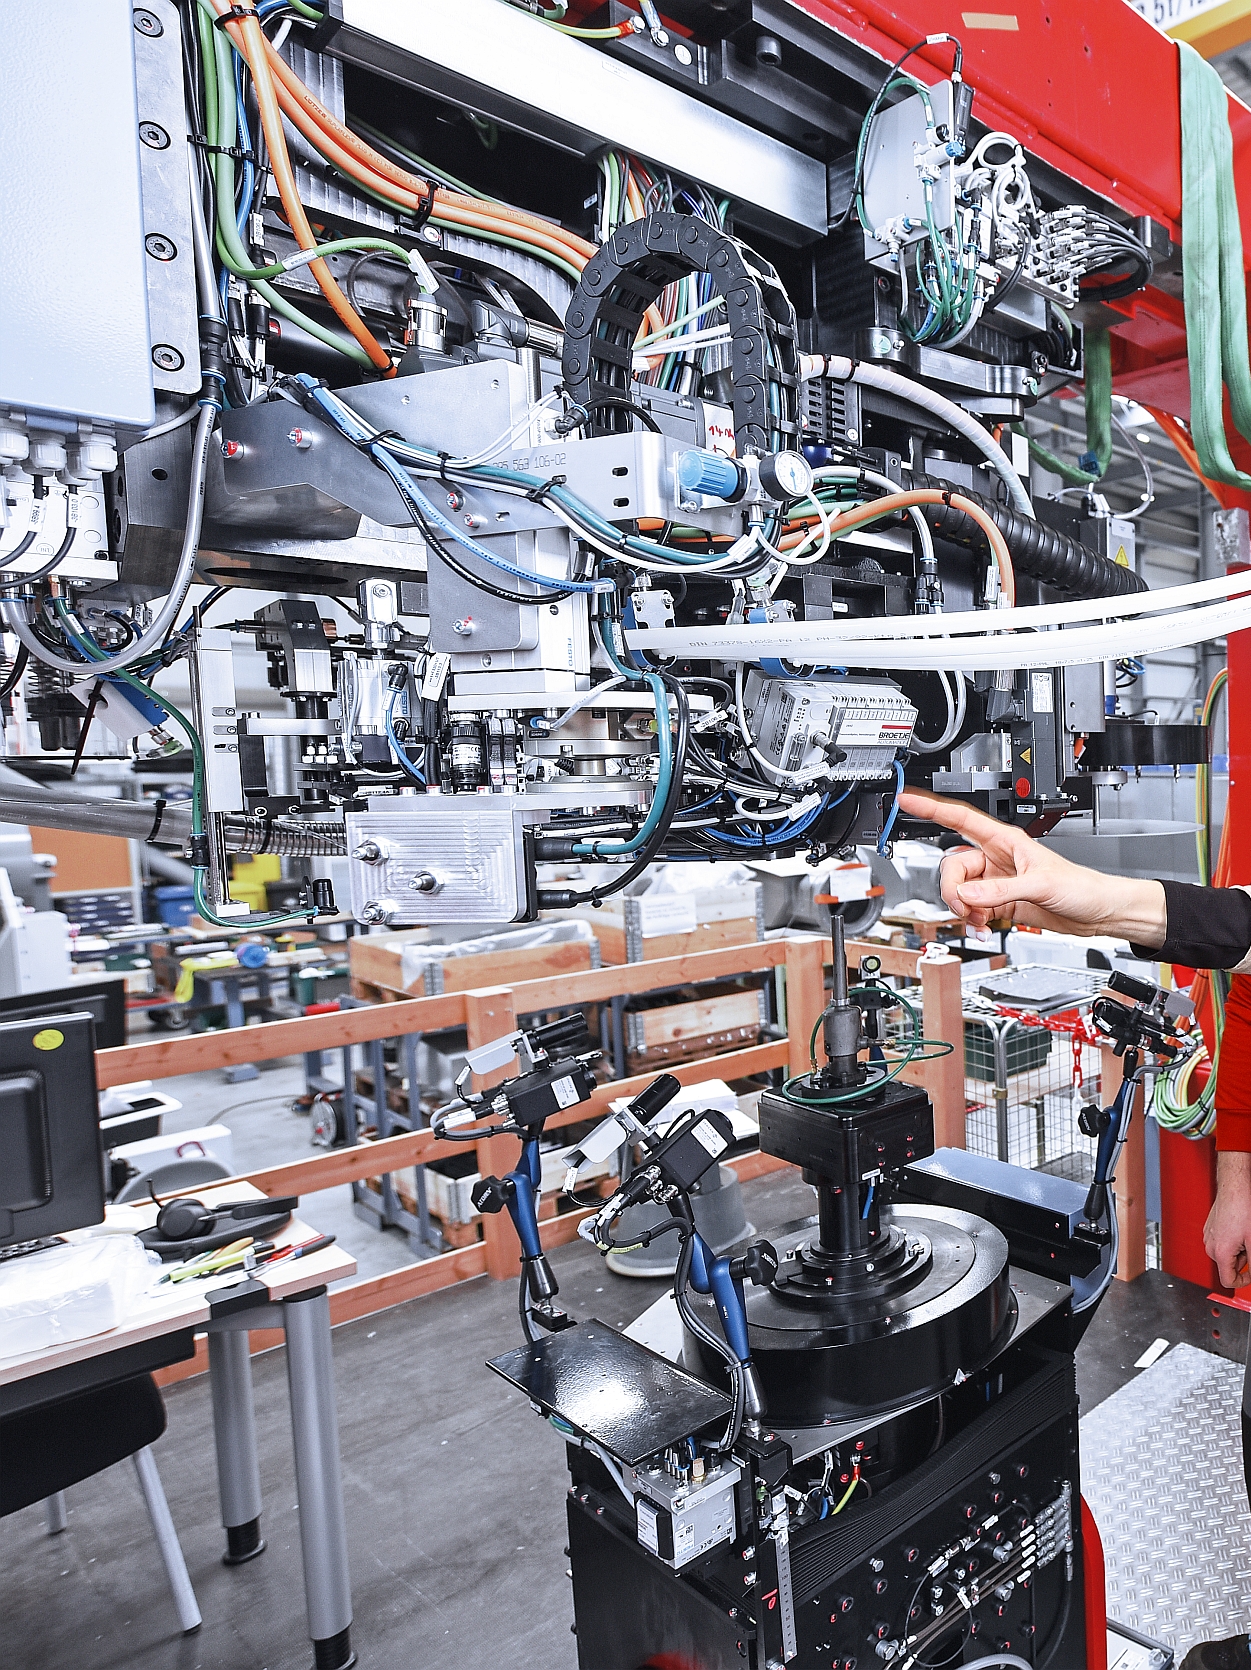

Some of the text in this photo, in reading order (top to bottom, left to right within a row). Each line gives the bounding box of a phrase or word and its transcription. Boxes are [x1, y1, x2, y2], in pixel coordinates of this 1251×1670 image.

[512, 457, 529, 471] 563
[534, 452, 567, 469] 106-02
[400, 690, 408, 716] FESTO
[878, 731, 911, 739] BROETJE
